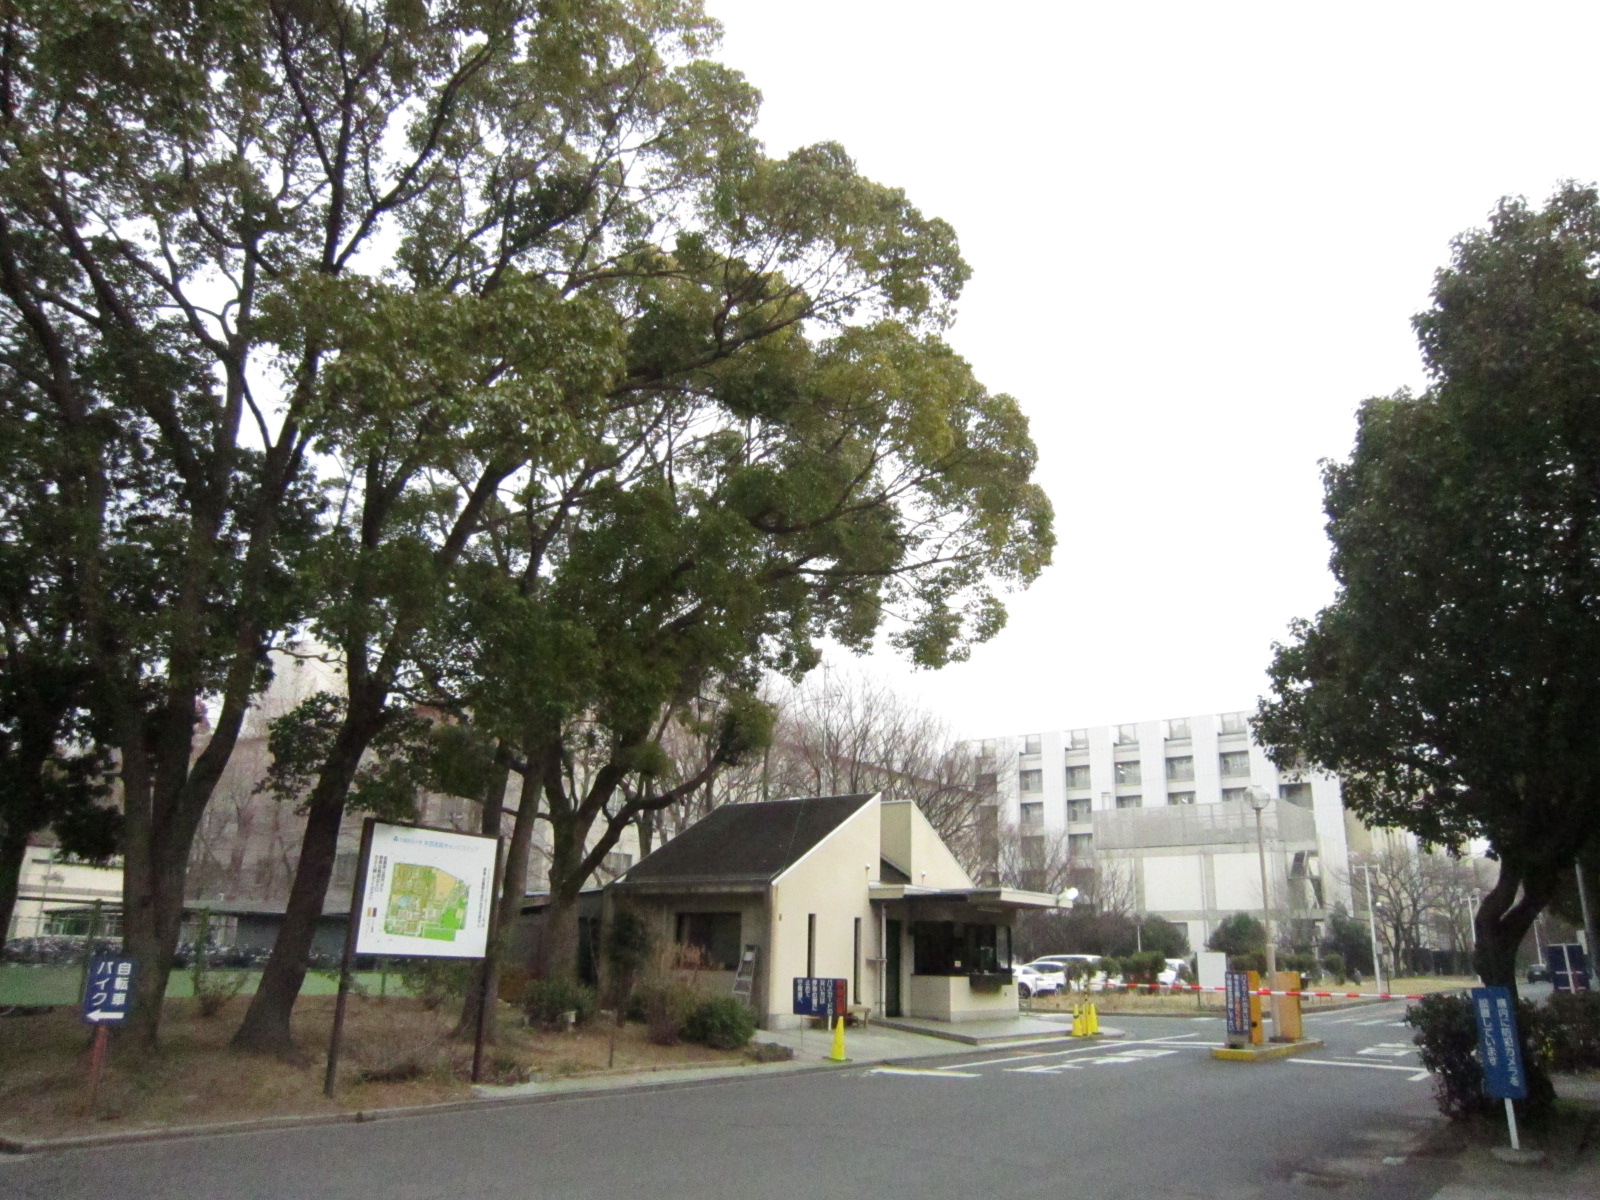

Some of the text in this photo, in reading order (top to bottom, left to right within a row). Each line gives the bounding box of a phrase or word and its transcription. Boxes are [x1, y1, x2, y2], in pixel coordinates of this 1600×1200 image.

[92, 961, 114, 1006] バイク
[111, 962, 132, 1006] 自転車
[1478, 998, 1497, 1066] 設置しています
